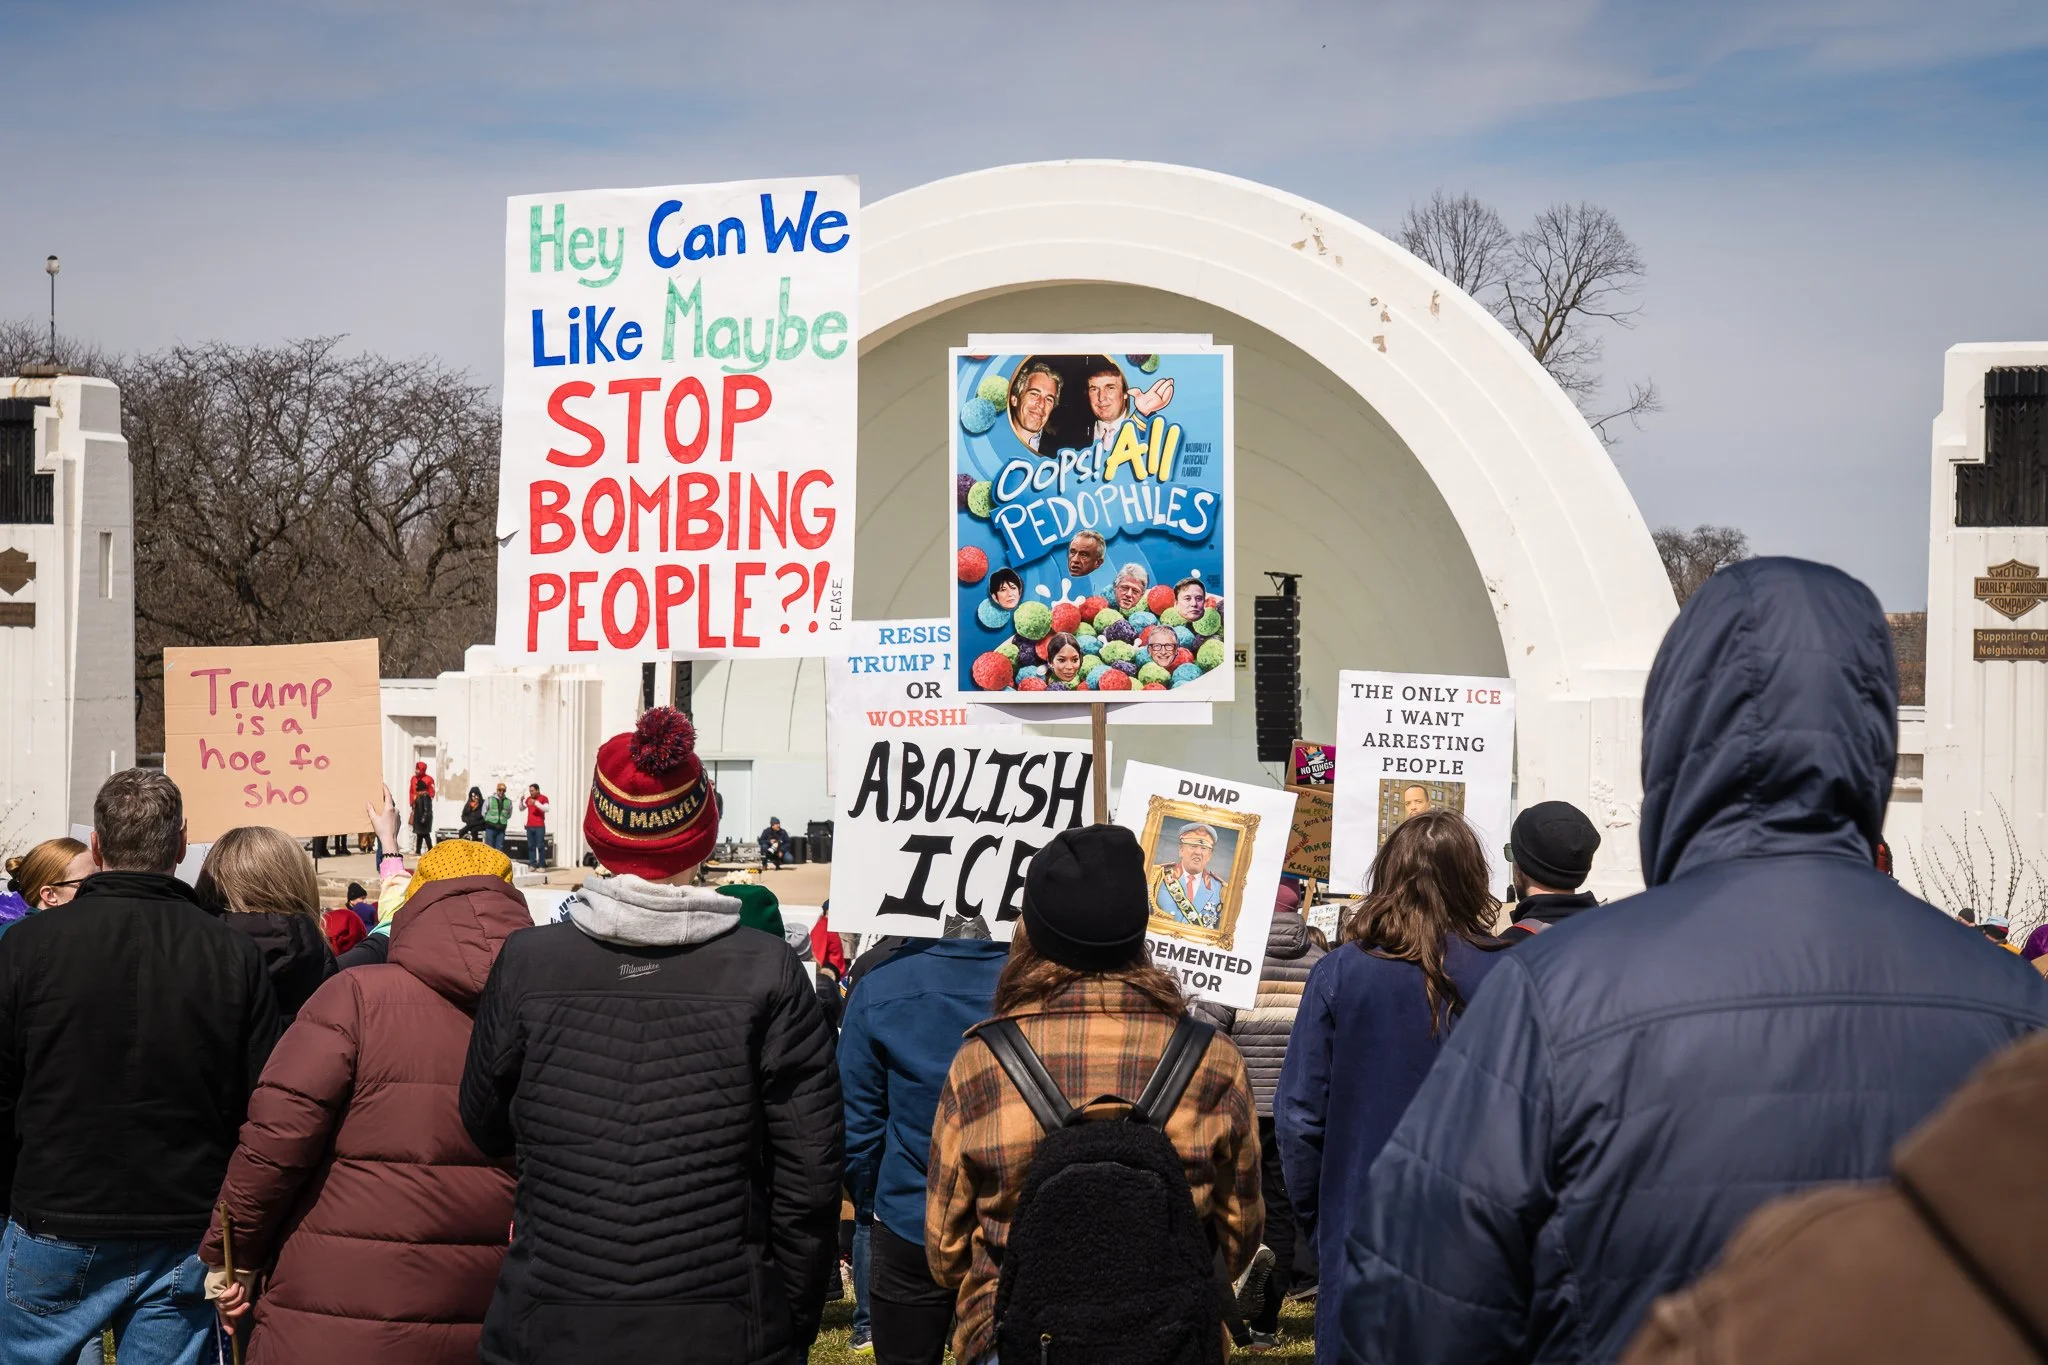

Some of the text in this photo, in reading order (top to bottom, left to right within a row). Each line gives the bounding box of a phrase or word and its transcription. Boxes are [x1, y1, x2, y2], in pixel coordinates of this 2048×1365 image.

[530, 190, 850, 288] Hey Can We
[661, 276, 848, 374] Maybe
[546, 374, 772, 468] STOP
[529, 469, 836, 555] BOMBING
[1995, 566, 2031, 577] MOTOR
[1979, 581, 2048, 594] HARLEY-DAVIDSON
[527, 560, 831, 652] PEOPLE?!
[829, 578, 843, 631] PLEASE
[1994, 598, 2036, 613] COMPANY
[879, 626, 951, 645] RESIS
[1976, 631, 2028, 643] Supporting
[1979, 645, 2046, 656] Neighborhood
[848, 654, 935, 674] TRUMP
[190, 668, 332, 719] Trump
[906, 681, 942, 699] OR
[1351, 684, 1501, 705] THE ONLY ICE
[235, 713, 303, 736] is a
[866, 708, 967, 728] WORSHI
[1386, 709, 1464, 727] I WANT
[1362, 732, 1485, 752] ARRESTING
[199, 738, 330, 775] hoe fo
[1382, 757, 1464, 775] PEOPLE
[1300, 761, 1334, 775] NO KINGS
[243, 781, 309, 808] sho
[847, 740, 1093, 829] ABOLISH
[1178, 779, 1240, 805] DUMP
[629, 794, 699, 828] MARVEL
[1303, 842, 1321, 853] PAM
[1288, 861, 1312, 873] KASH
[1144, 938, 1252, 976] DEMENTED
[618, 962, 660, 976] Milwaukee
